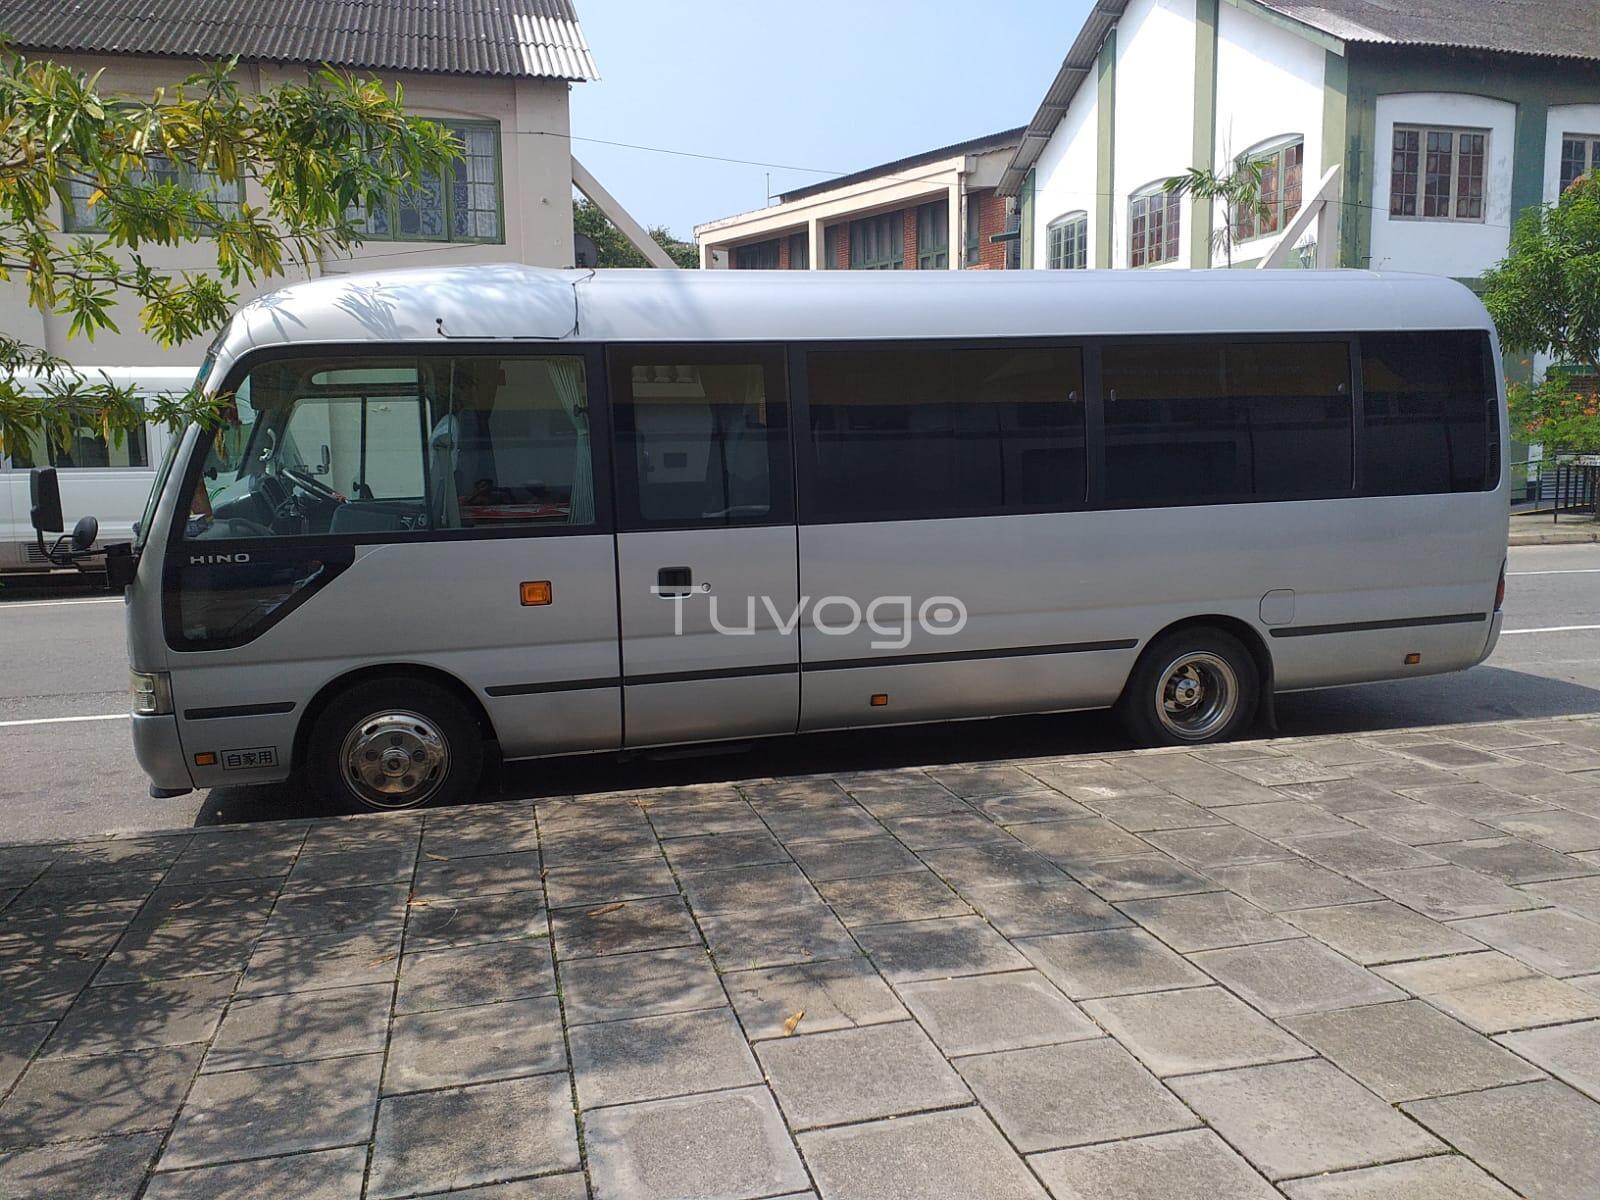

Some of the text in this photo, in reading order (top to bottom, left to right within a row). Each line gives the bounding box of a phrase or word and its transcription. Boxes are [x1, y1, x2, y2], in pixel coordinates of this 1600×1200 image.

[190, 553, 250, 564] HINO
[227, 751, 273, 767] 自家用
